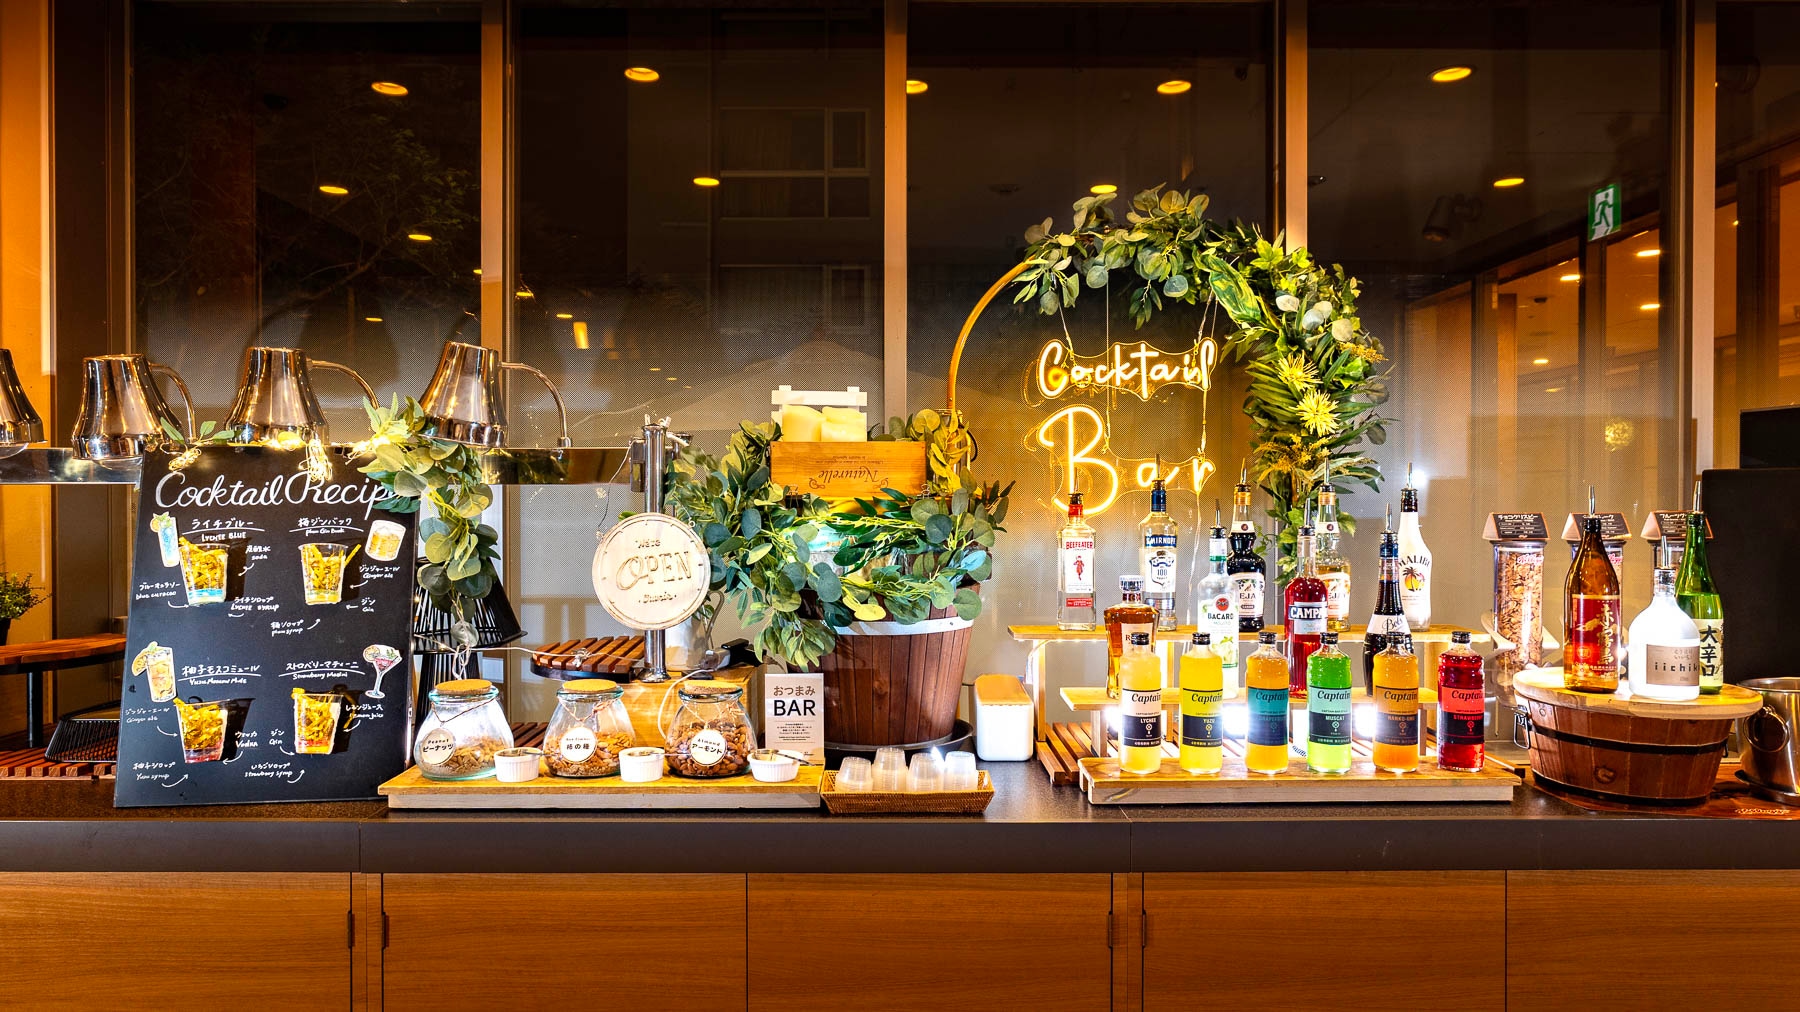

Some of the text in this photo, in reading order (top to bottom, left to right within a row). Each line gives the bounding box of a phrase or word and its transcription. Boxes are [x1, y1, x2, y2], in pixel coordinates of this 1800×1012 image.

[1038, 340, 1214, 400] Cocktail
[1037, 405, 1215, 516] Bar
[818, 465, 879, 484] Naturelle
[155, 471, 398, 520] Cocktail Recip
[191, 517, 255, 530] ライチブルー
[228, 531, 248, 540] BLUE
[1065, 541, 1094, 549] BEEFEATER
[616, 550, 692, 591] OPEN
[361, 597, 376, 606] ジン
[1290, 606, 1322, 619] CAMP
[1699, 624, 1719, 677] 大辛口
[1654, 662, 1699, 672] iichik
[773, 685, 816, 697] おつまみ
[773, 699, 816, 717] BAR
[270, 728, 285, 737] ジン
